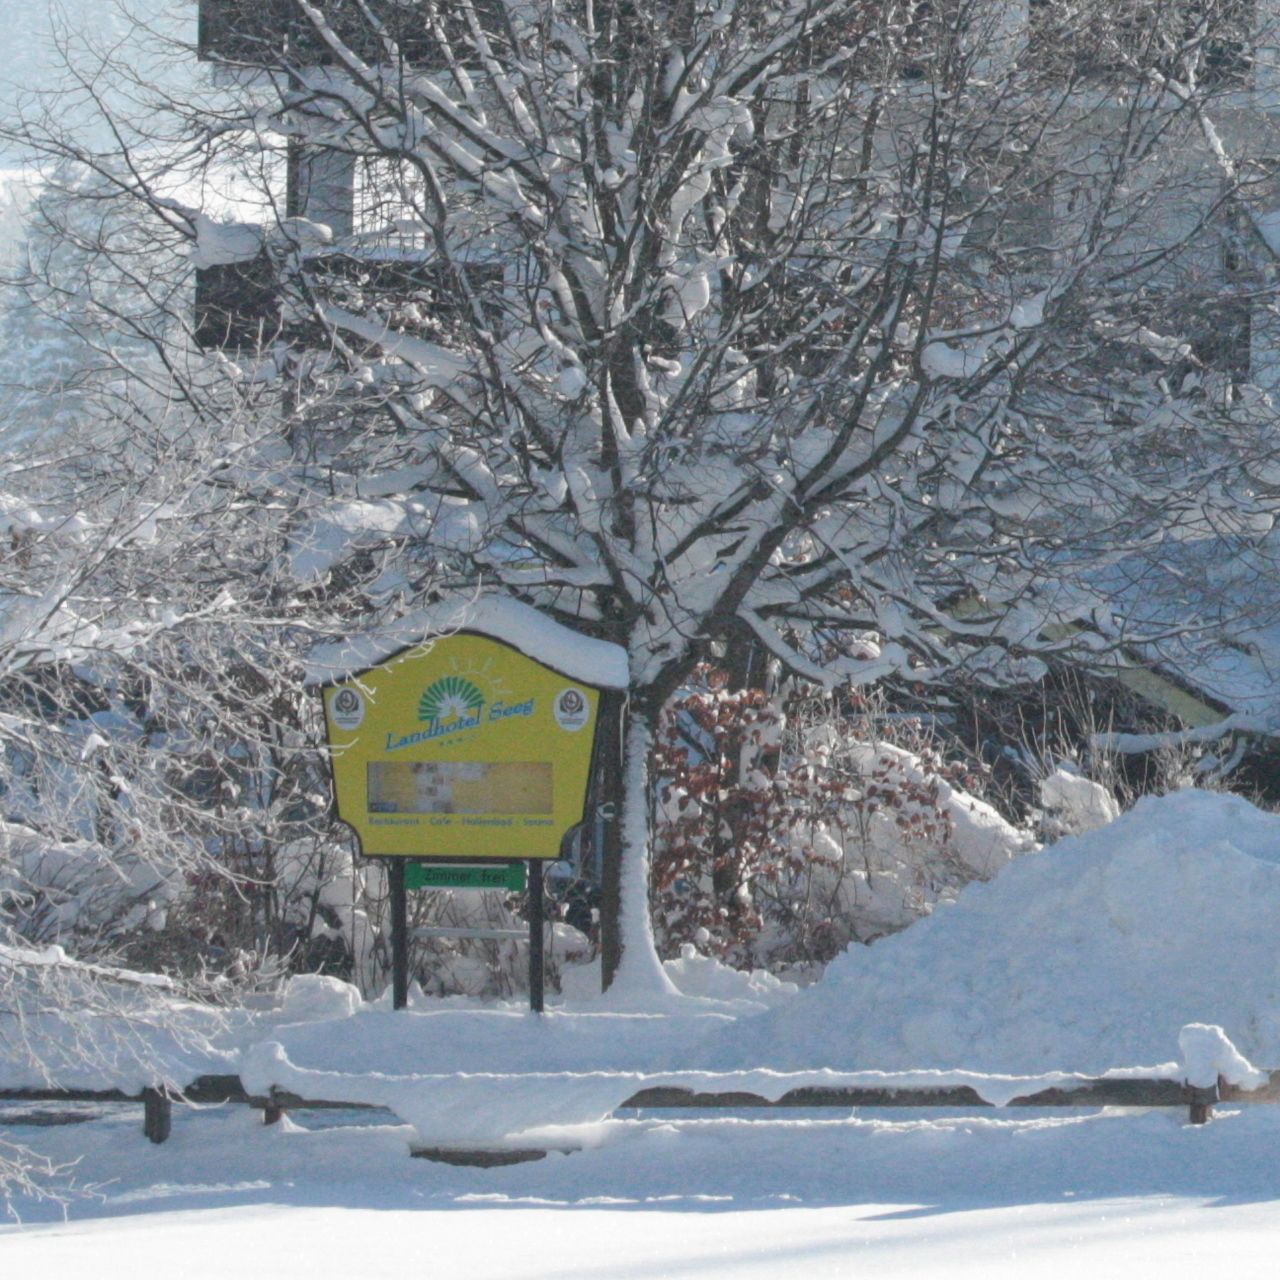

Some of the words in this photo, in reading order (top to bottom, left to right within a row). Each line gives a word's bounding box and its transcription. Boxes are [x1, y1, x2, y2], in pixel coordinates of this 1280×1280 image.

[384, 703, 482, 752] Landhotel
[488, 698, 536, 721] Seeg
[425, 868, 472, 881] Zimmer
